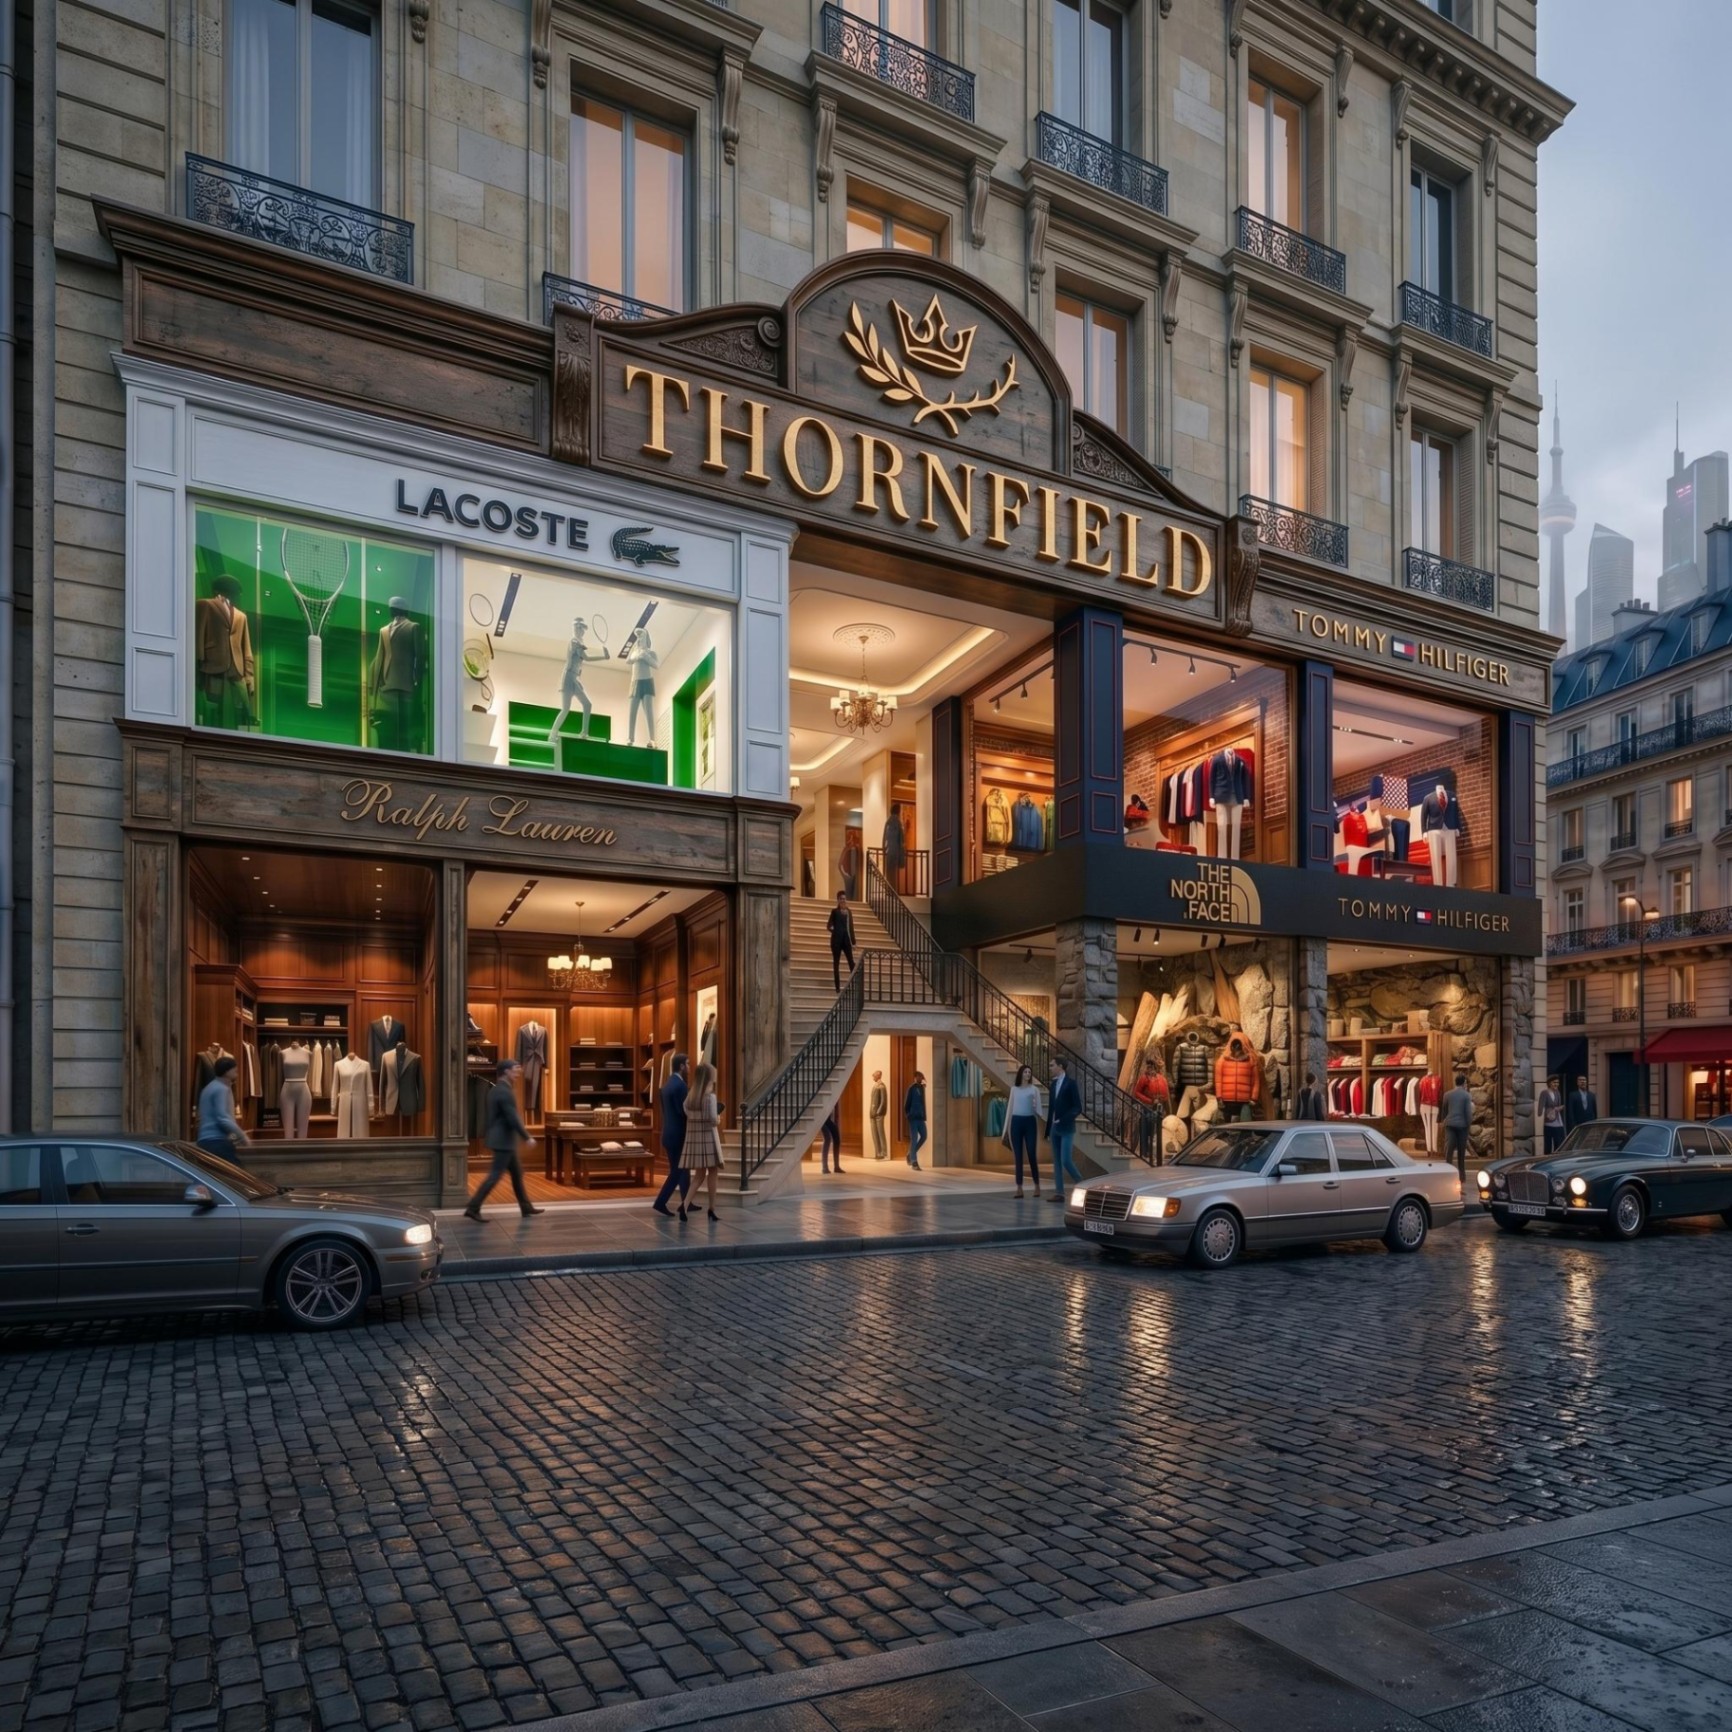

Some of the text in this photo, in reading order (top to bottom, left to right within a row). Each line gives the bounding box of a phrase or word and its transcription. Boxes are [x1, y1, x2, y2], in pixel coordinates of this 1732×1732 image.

[625, 365, 1212, 598] THORNFIELD
[396, 478, 589, 551] LACOSTE
[1292, 608, 1510, 686] TOMMY HILFIGER
[340, 778, 618, 847] Ralph Lauren
[1170, 878, 1230, 903] NORTH
[1196, 862, 1230, 884] THE
[1188, 900, 1230, 922] FACE
[1337, 897, 1511, 933] TOMMY HILFIGER
